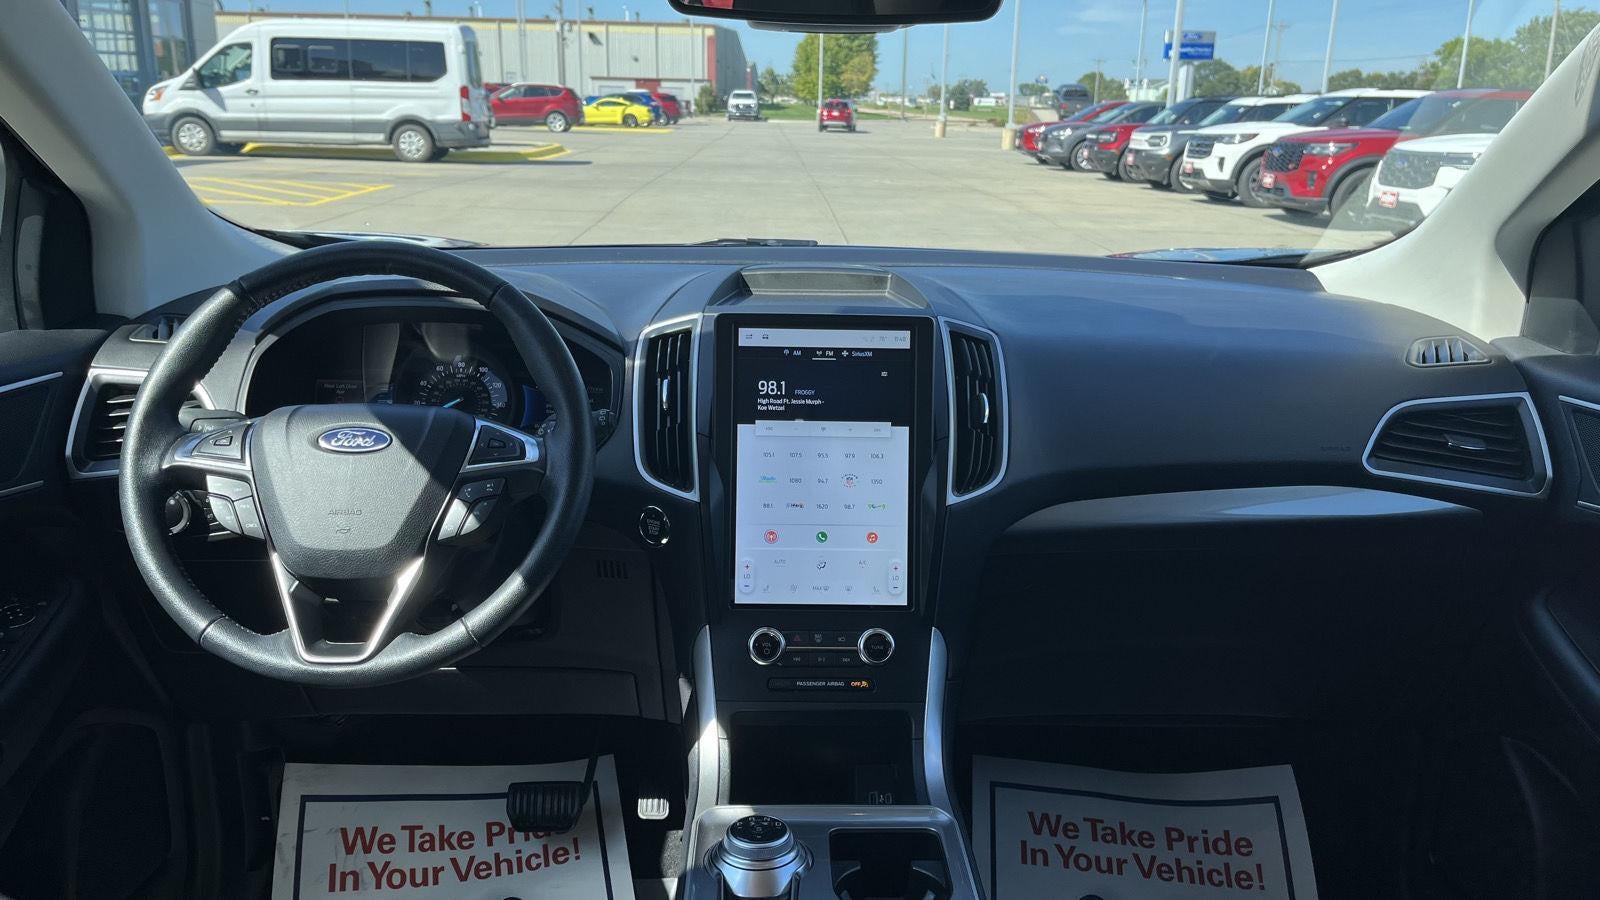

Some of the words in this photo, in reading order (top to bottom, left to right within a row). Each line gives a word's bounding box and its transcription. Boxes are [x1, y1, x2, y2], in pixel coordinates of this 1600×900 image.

[758, 380, 786, 394] 98.1
[331, 430, 376, 447] Ford
[340, 826, 396, 856] We
[401, 824, 475, 852] Take
[1027, 811, 1080, 840] We
[1083, 818, 1155, 848] Take
[1164, 826, 1253, 857] Pride
[328, 863, 360, 892] In
[366, 860, 444, 890] Your
[450, 837, 580, 882] Vehicle!
[1020, 840, 1048, 867] In
[1054, 844, 1128, 876] Your
[1132, 852, 1265, 891] Vehicle!
